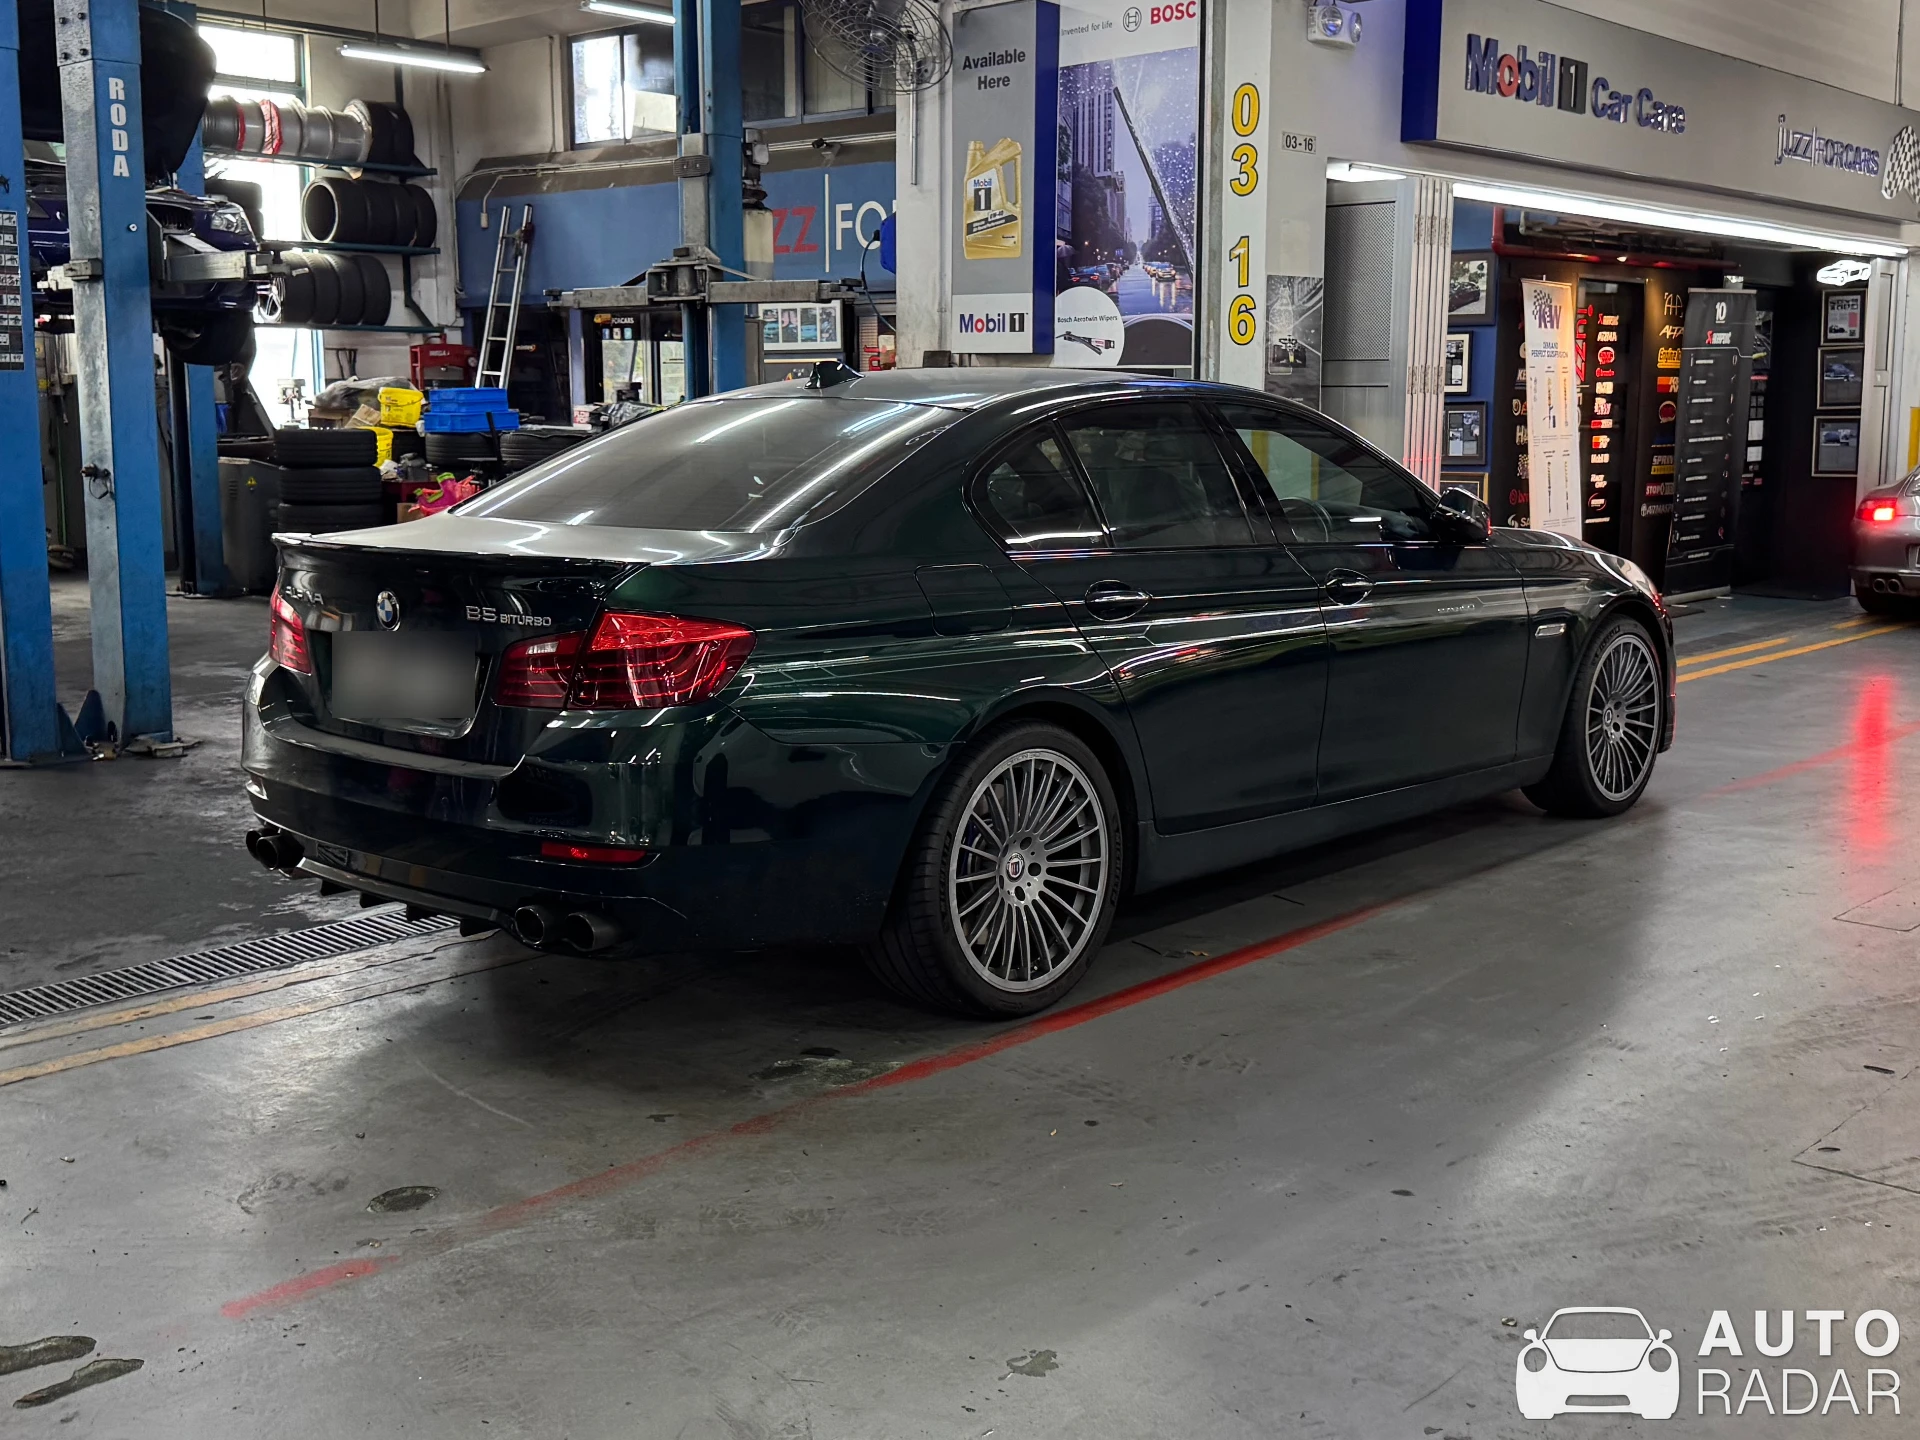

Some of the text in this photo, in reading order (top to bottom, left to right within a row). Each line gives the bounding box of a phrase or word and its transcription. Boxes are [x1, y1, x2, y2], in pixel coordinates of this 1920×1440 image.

[1150, 1, 1197, 24] BOSC
[1061, 23, 1089, 36] Invented
[1091, 22, 1100, 31] for
[962, 48, 1026, 70] Available
[978, 75, 1011, 90] Here
[1465, 33, 1556, 108] Mobil
[1592, 76, 1633, 124] Car
[1636, 88, 1686, 134] Care
[108, 77, 130, 177] RODA
[1285, 134, 1314, 152] 03-16
[973, 179, 992, 187] Mobil
[835, 200, 896, 250] FO
[959, 313, 1006, 333] Mobil
[1057, 316, 1073, 324] Bosch
[1099, 314, 1118, 322] Wipers
[465, 605, 552, 626] B5 BITURBO
